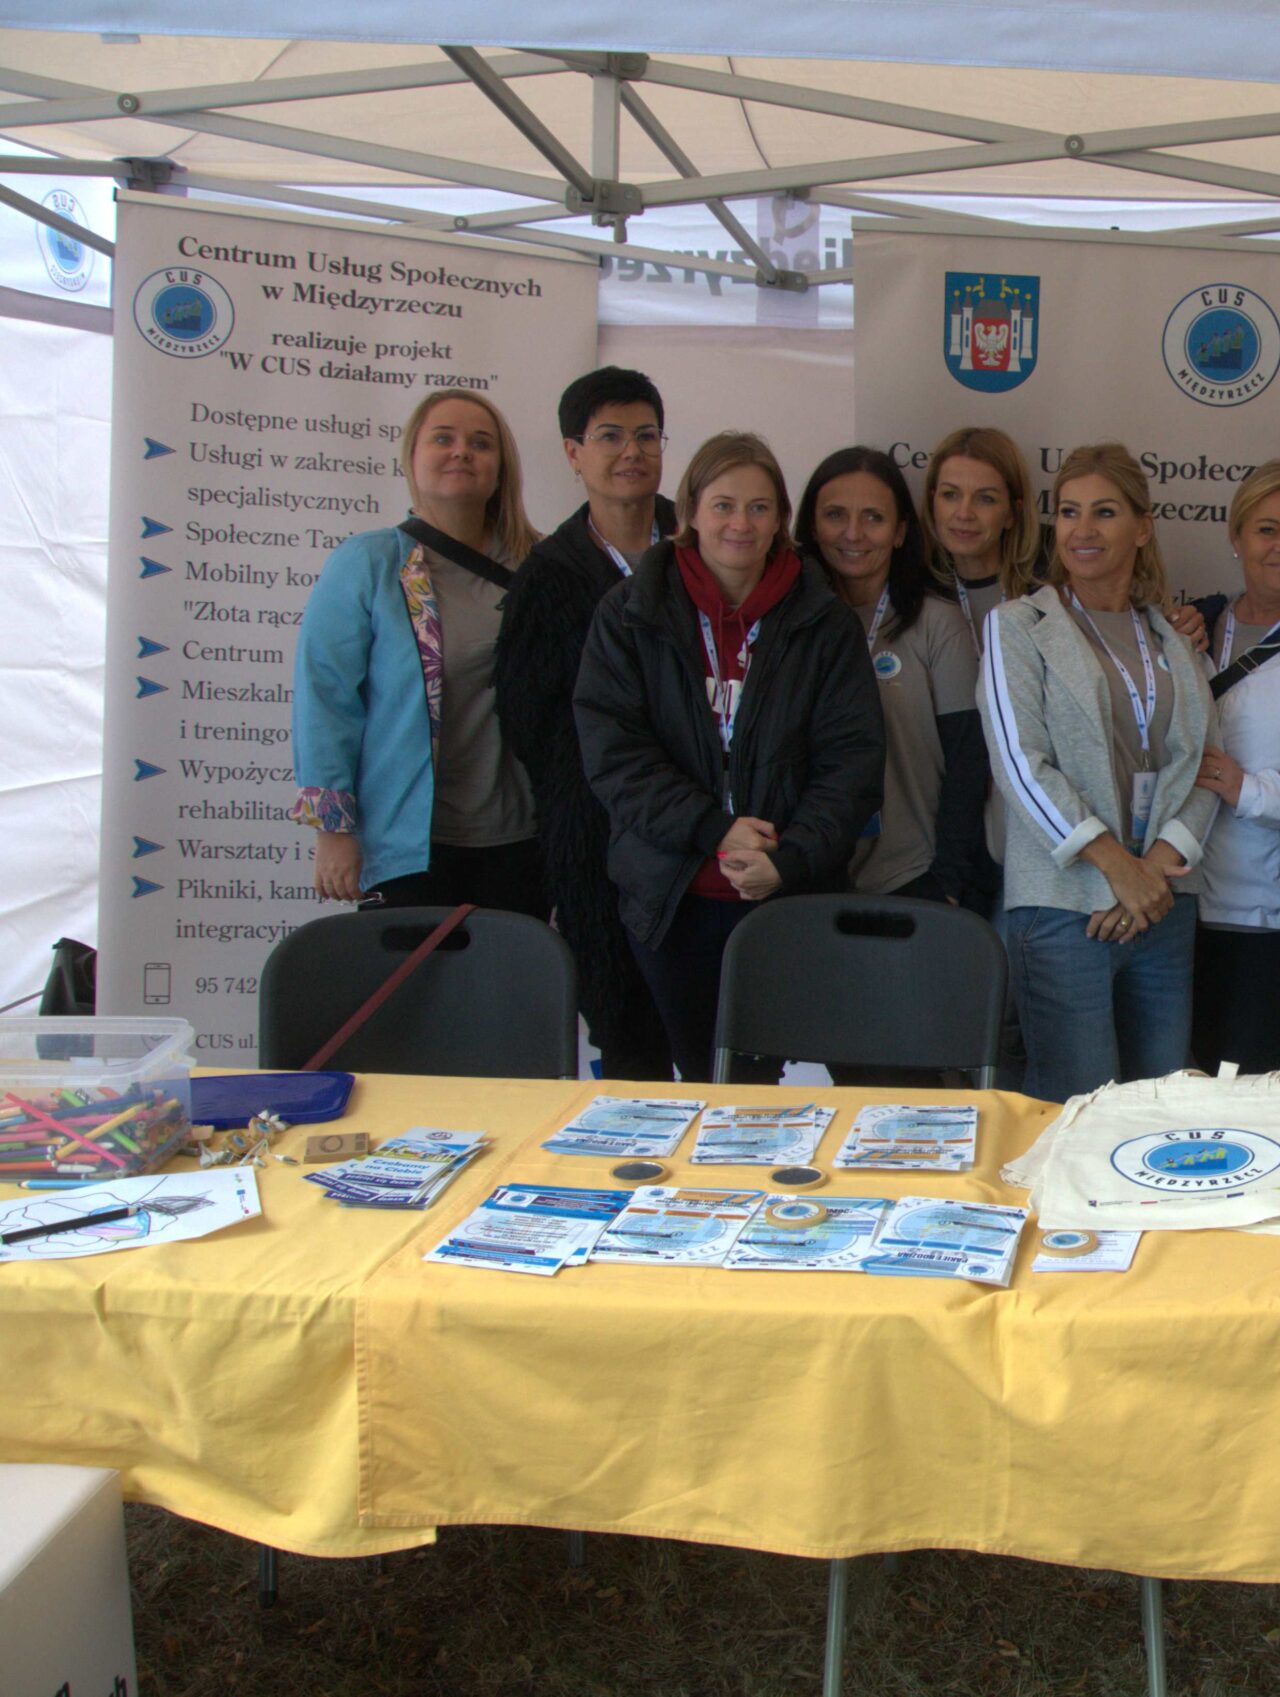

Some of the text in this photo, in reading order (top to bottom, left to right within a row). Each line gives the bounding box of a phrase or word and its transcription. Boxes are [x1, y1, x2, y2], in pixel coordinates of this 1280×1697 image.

[165, 271, 203, 285] CUS
[178, 236, 542, 298] Centrum Usług Społecznych
[261, 282, 463, 318] w Międzyrzeczu
[1201, 288, 1245, 306] CUS
[272, 331, 453, 361] realizuje projekt
[261, 355, 311, 376] CUS
[319, 361, 416, 388] działamy
[424, 372, 498, 391] razem"
[1177, 369, 1264, 399] MIĘDZYRZECZ
[191, 403, 298, 431] Dostępne
[305, 414, 371, 439] usługi
[189, 442, 262, 469] Usługi
[269, 453, 288, 468] w
[294, 452, 386, 475] zakresie
[187, 486, 380, 515] specjalistycznych
[185, 521, 299, 547] Społeczne
[185, 561, 279, 588] Mobilny
[184, 600, 304, 628] "Złota rącz
[182, 640, 284, 663] Centrum
[181, 679, 294, 703] Mieszkaln
[180, 719, 292, 745] i treningo
[179, 759, 294, 785] Wypożycz
[178, 800, 294, 821] rehabilitac
[177, 839, 287, 864] Warsztaty
[294, 841, 300, 861] i
[177, 878, 262, 902] Pikniki,
[195, 977, 258, 994] 95 742
[195, 1033, 257, 1049] CUS ul.
[1165, 1131, 1226, 1142] CUS
[1134, 1168, 1264, 1187] MIĘDZYRZECZ
